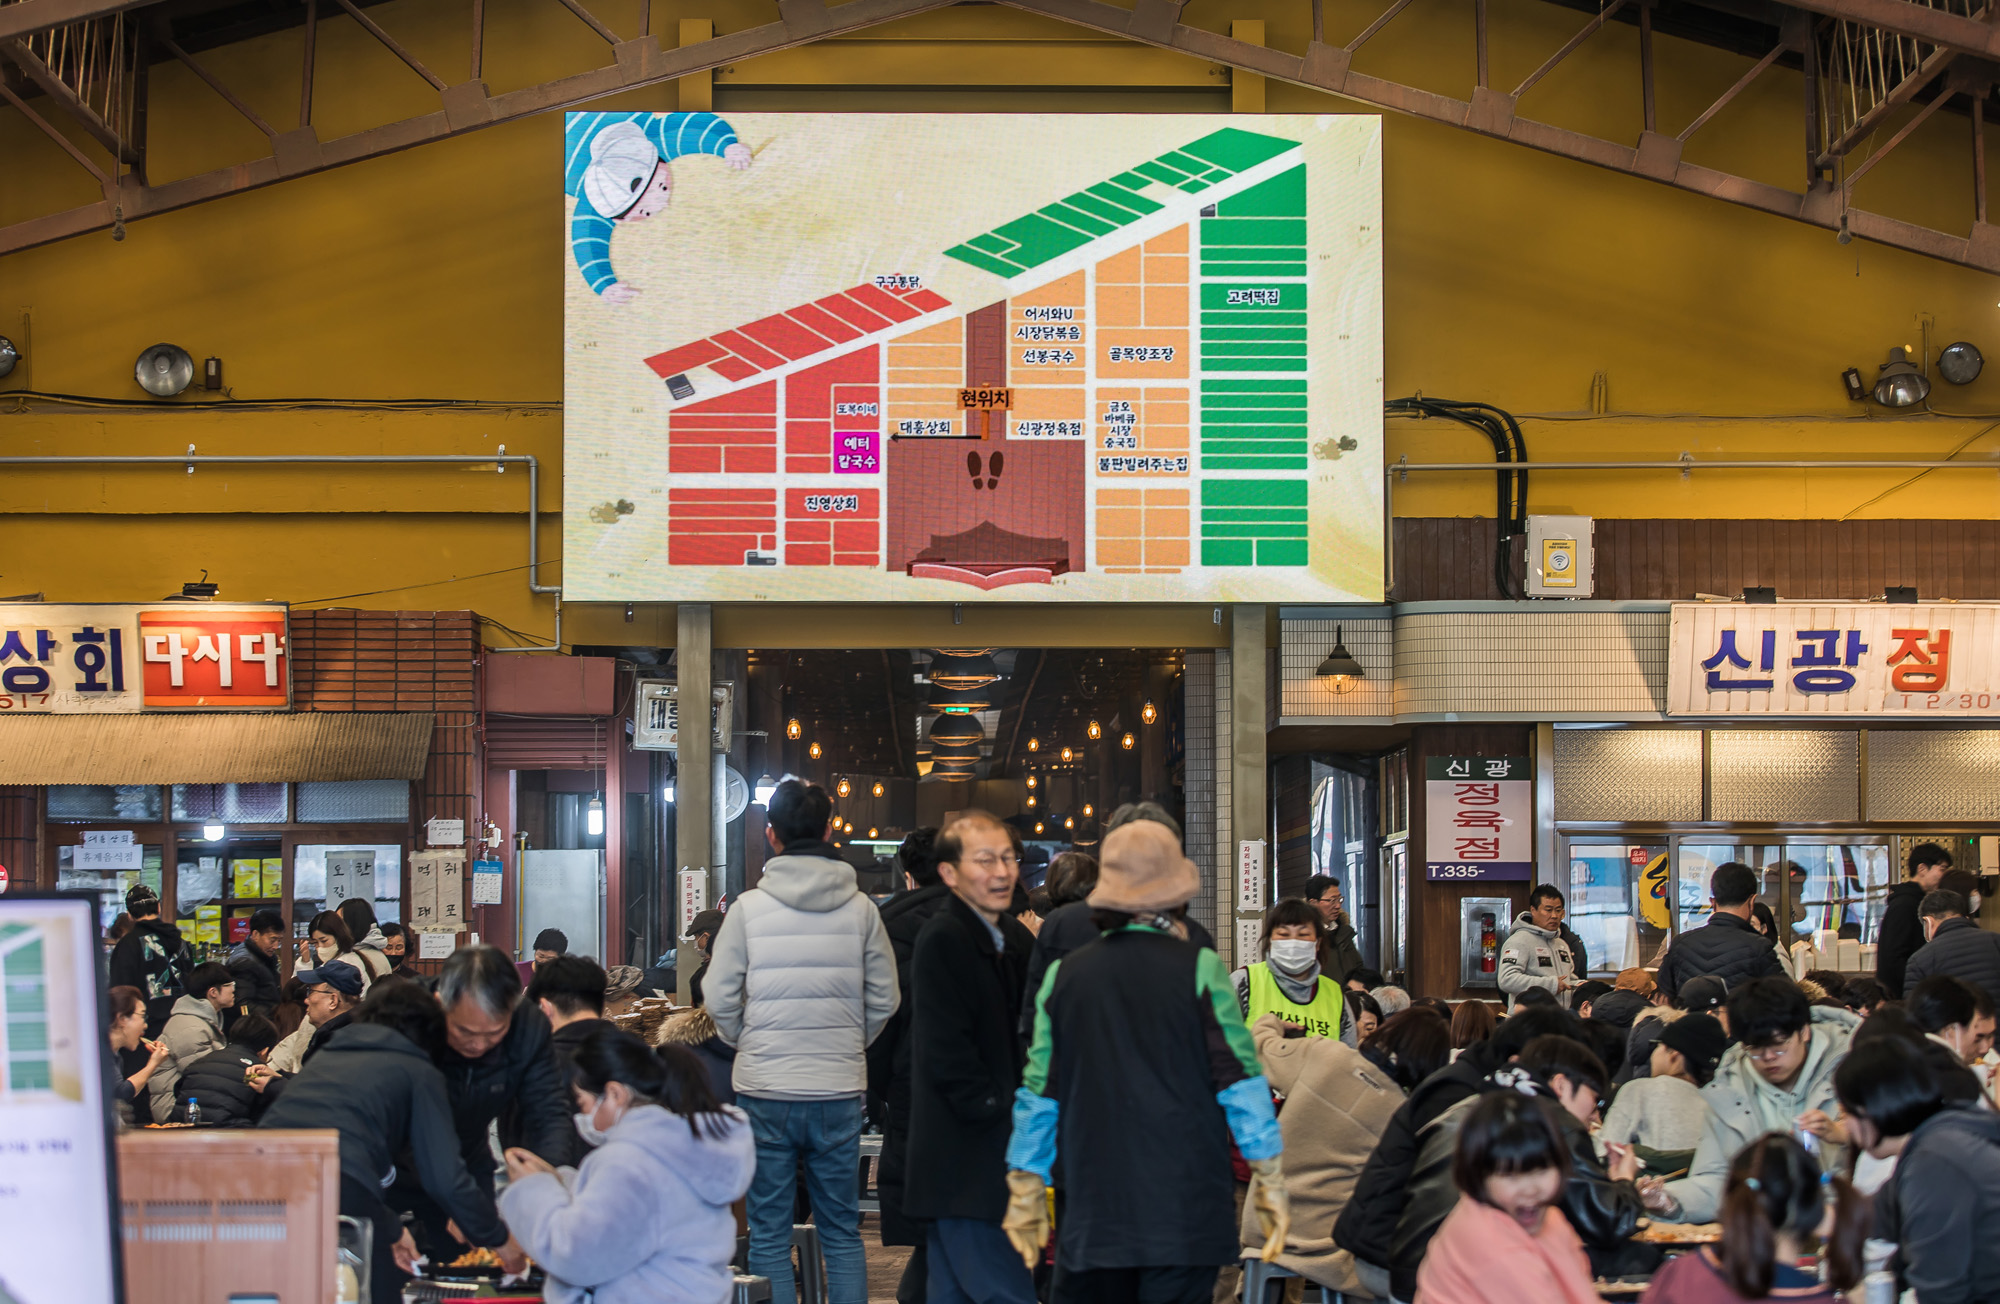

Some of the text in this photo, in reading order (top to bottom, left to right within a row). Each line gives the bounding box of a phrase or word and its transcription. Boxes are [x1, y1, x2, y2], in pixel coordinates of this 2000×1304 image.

[1228, 290, 1278, 304] 고려떡집
[1025, 307, 1073, 321] 어서와U
[1016, 326, 1080, 341] 시장닭볶음
[1023, 349, 1075, 363] 선봉국수
[1109, 347, 1174, 361] 골목양조장
[960, 389, 1010, 408] 현위치
[1109, 401, 1130, 413] 금오
[1104, 413, 1136, 424] 바베큐
[899, 420, 950, 435] 대흥상회
[1018, 421, 1081, 436] 신광정육점
[1110, 425, 1131, 436] 시장
[1104, 437, 1136, 449] 중국집
[838, 454, 876, 469] 칼국수
[1099, 457, 1188, 472] 불판빌려주는집
[806, 496, 857, 510] 진영상회
[144, 633, 284, 688] 다시다
[1453, 783, 1505, 860] 정육점
[332, 864, 345, 899] 오징
